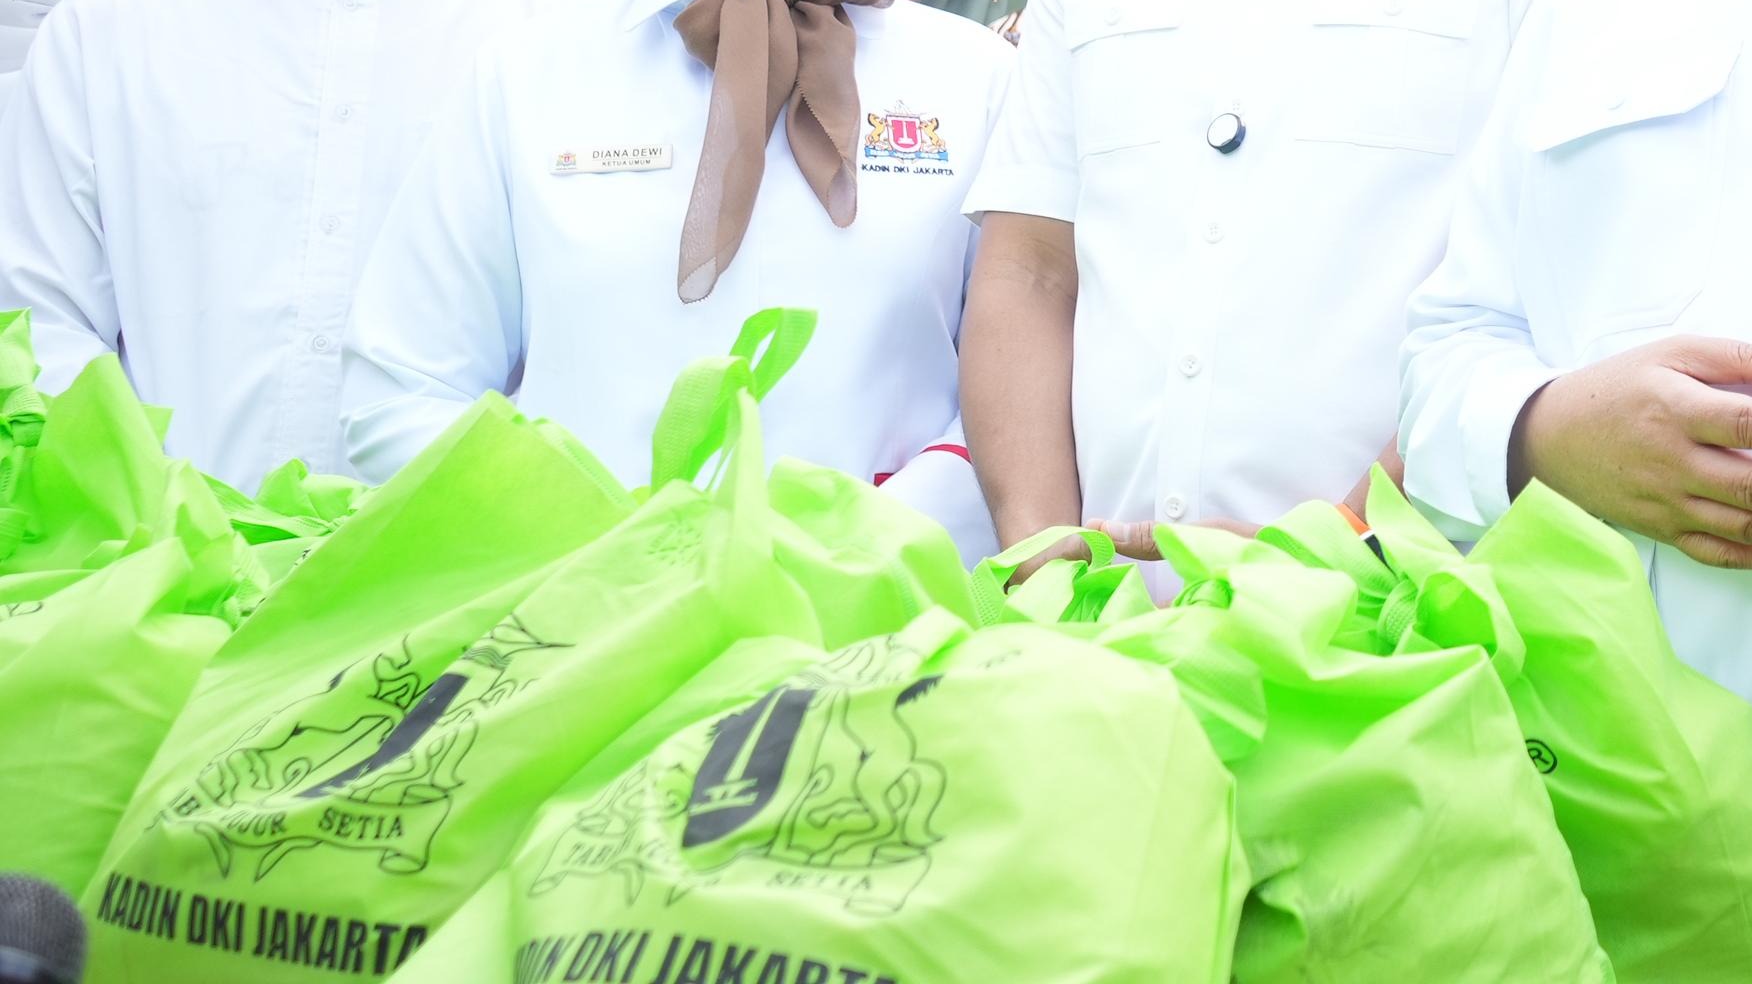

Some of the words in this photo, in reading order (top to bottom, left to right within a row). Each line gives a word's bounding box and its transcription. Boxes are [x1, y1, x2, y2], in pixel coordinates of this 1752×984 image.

[592, 148, 629, 159] DIANA
[632, 147, 663, 157] DEWI
[861, 163, 890, 173] KADIN
[893, 166, 910, 174] DKI
[913, 167, 954, 176] JAKARTA
[318, 806, 406, 841] SETIA
[97, 871, 182, 941] KADIN
[186, 894, 246, 954] DKI
[562, 929, 652, 984] DKI
[648, 935, 898, 984] JAKA
